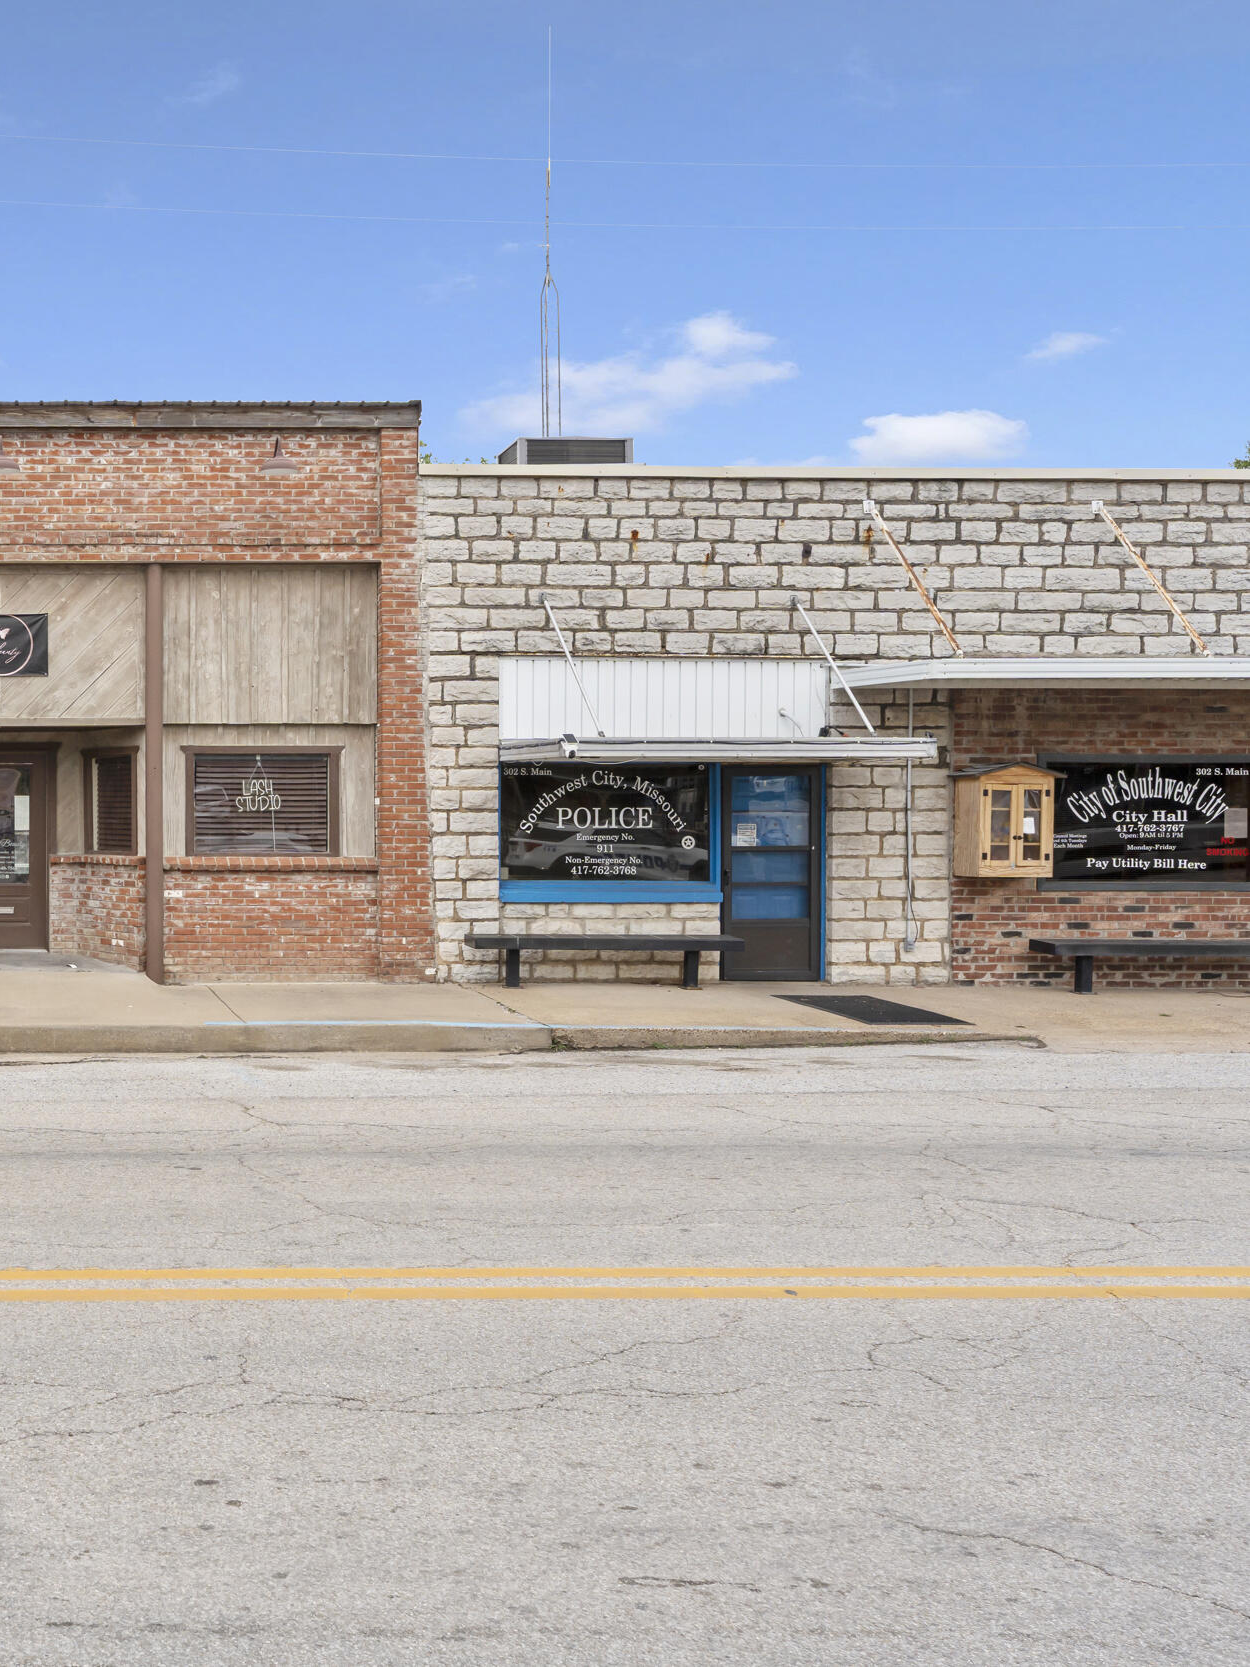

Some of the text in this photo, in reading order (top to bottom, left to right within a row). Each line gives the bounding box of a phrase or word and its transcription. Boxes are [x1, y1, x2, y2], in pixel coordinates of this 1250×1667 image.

[242, 780, 273, 796] LASH
[1066, 791, 1106, 823] City
[1102, 774, 1120, 806] of
[1118, 767, 1200, 805] Southwest
[1196, 784, 1229, 824] City
[236, 795, 281, 812] STUDIO
[520, 771, 686, 834] Southwest City, Missouri
[556, 807, 652, 829] POLICE
[1113, 810, 1188, 824] City Hall
[576, 833, 635, 842] Emergency No.
[597, 845, 614, 853] 911
[1206, 848, 1249, 856] SMOKING
[565, 857, 627, 865] Non-Emergency
[1086, 858, 1206, 870] Pay Utility Bill Here
[571, 866, 637, 875] 417-762-3768
